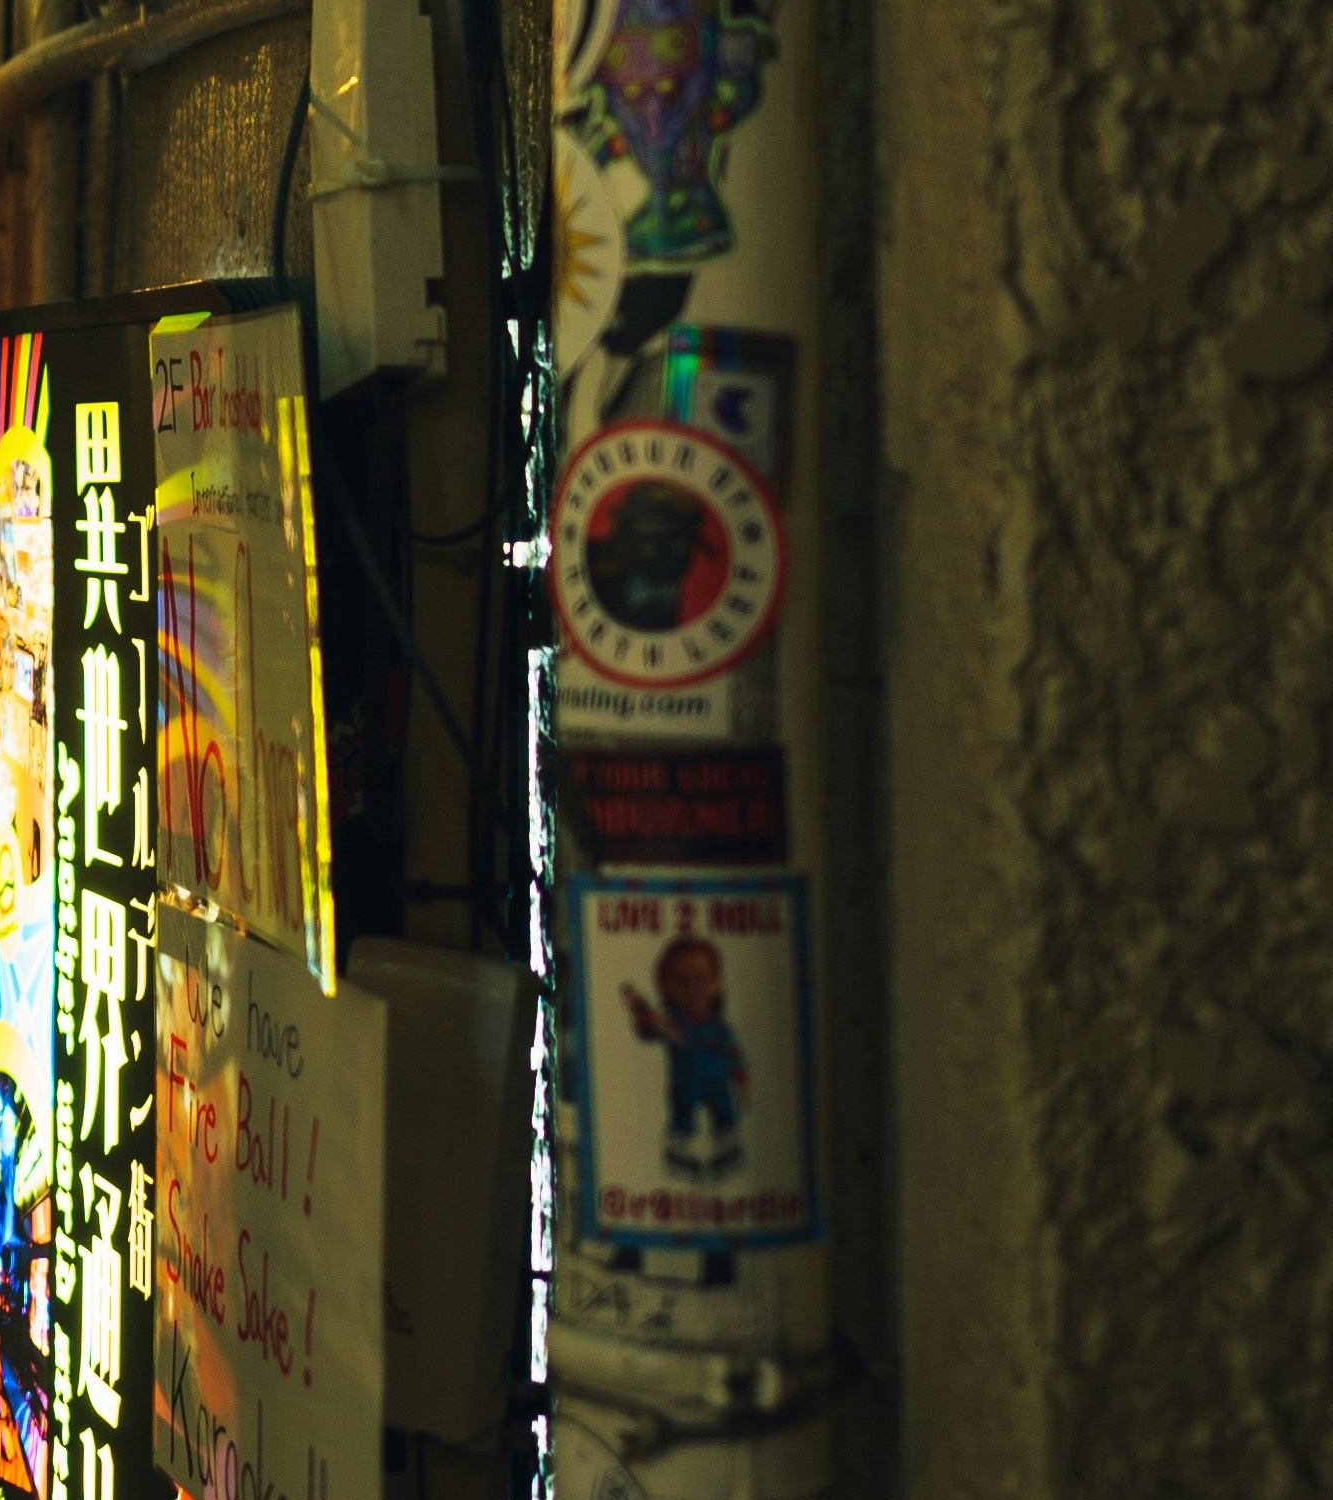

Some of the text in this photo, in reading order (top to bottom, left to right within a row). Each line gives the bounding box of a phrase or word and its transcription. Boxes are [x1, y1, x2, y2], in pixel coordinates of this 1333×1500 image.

[154, 356, 185, 435] 2F
[189, 349, 217, 434] Bar
[162, 532, 227, 892] No
[185, 943, 306, 1081] We have
[167, 1031, 220, 1166] Fire
[165, 1177, 226, 1327] Snake
